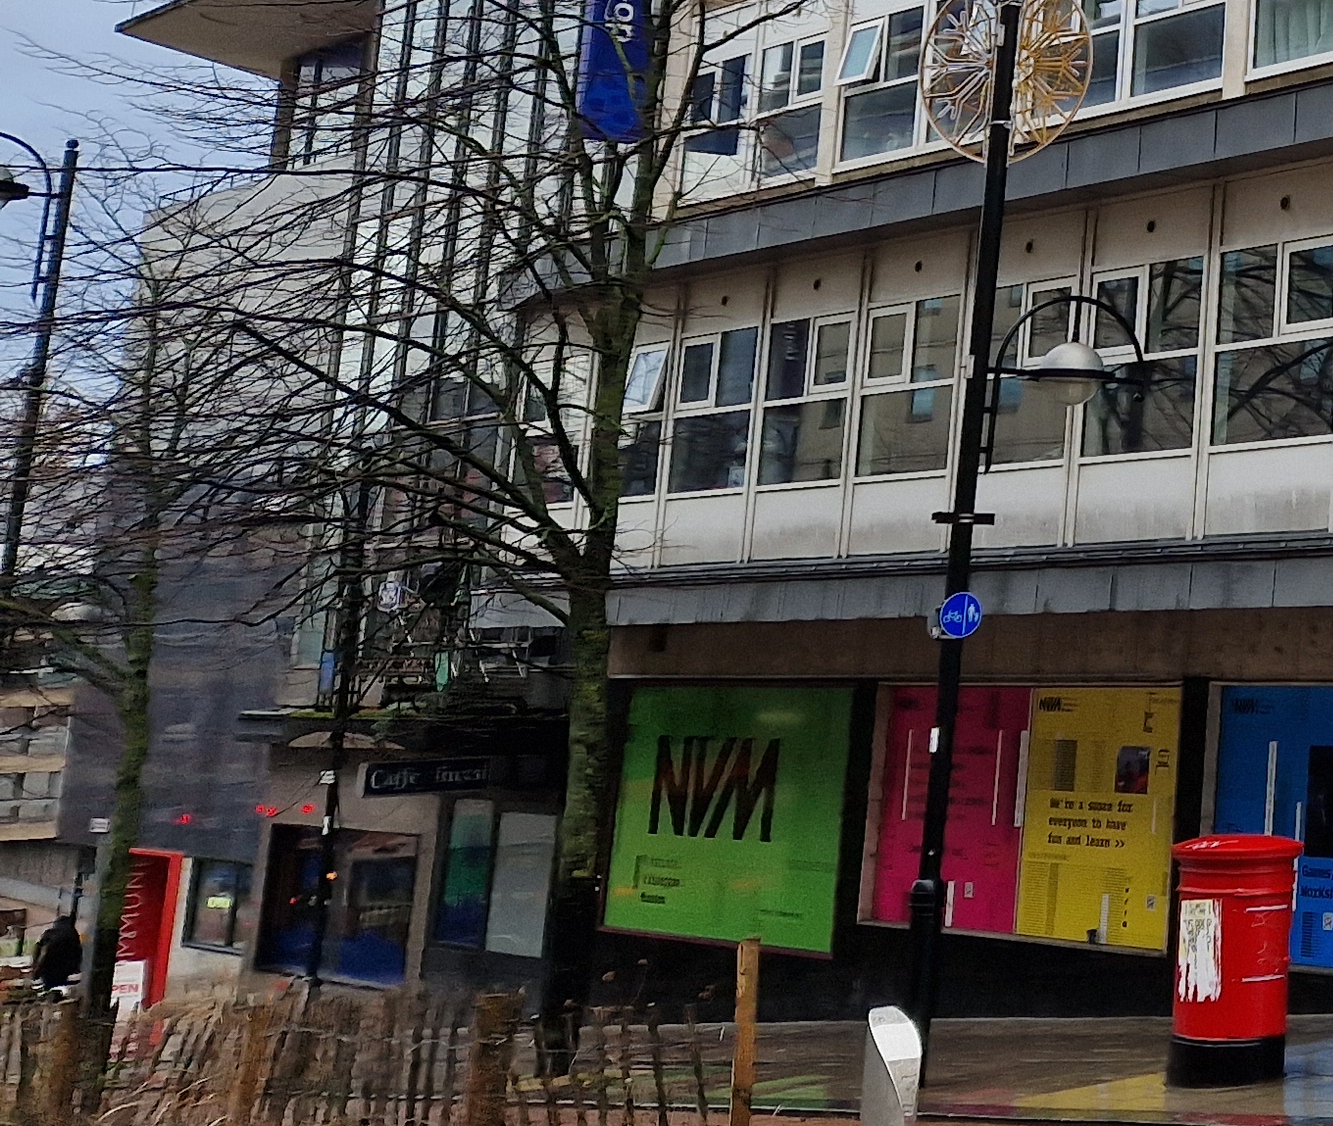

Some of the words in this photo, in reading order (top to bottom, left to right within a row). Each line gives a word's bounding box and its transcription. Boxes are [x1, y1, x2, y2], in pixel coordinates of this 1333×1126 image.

[647, 735, 780, 842] NVM
[1117, 800, 1134, 813] for
[1086, 834, 1111, 848] learn
